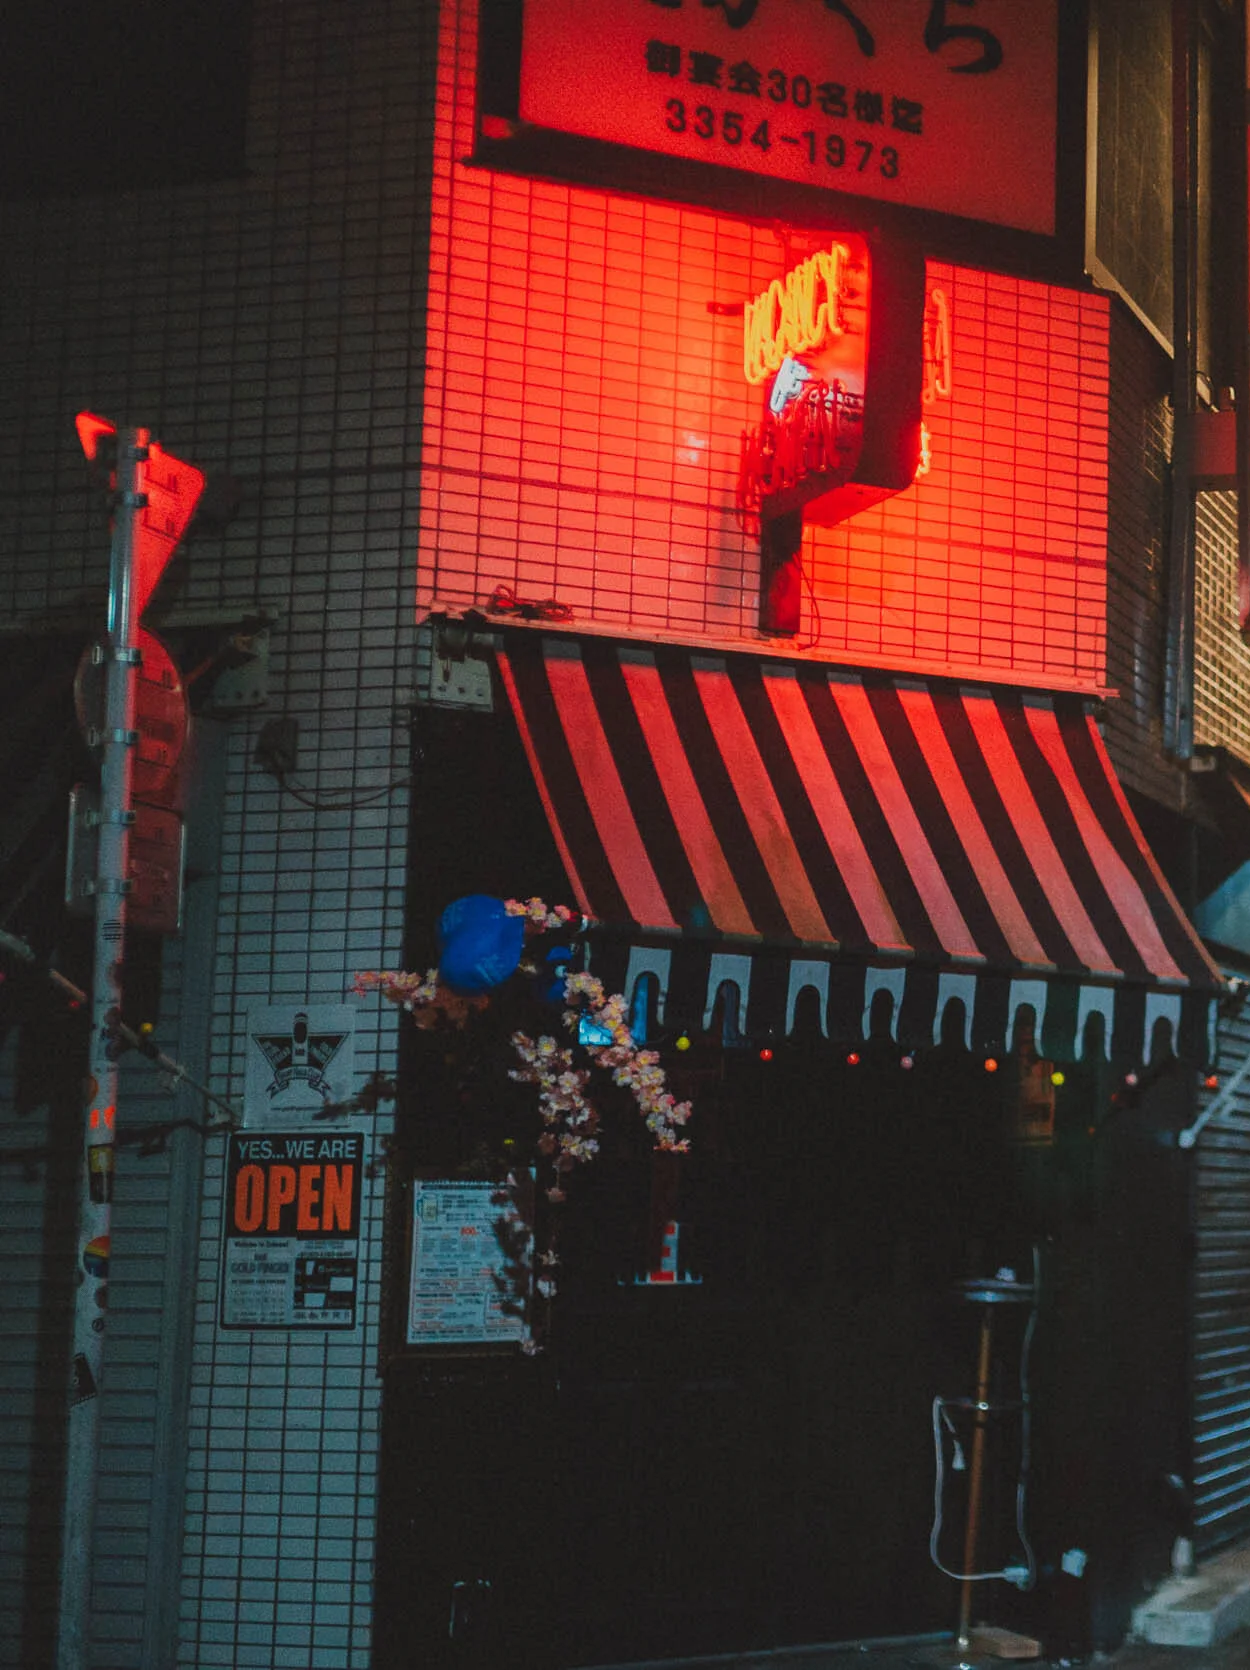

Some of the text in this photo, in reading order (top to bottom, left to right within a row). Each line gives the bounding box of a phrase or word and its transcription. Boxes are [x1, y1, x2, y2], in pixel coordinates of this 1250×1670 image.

[665, 97, 900, 179] 3354-1973
[318, 1140, 357, 1158] ARE
[234, 1164, 353, 1232] OPEN
